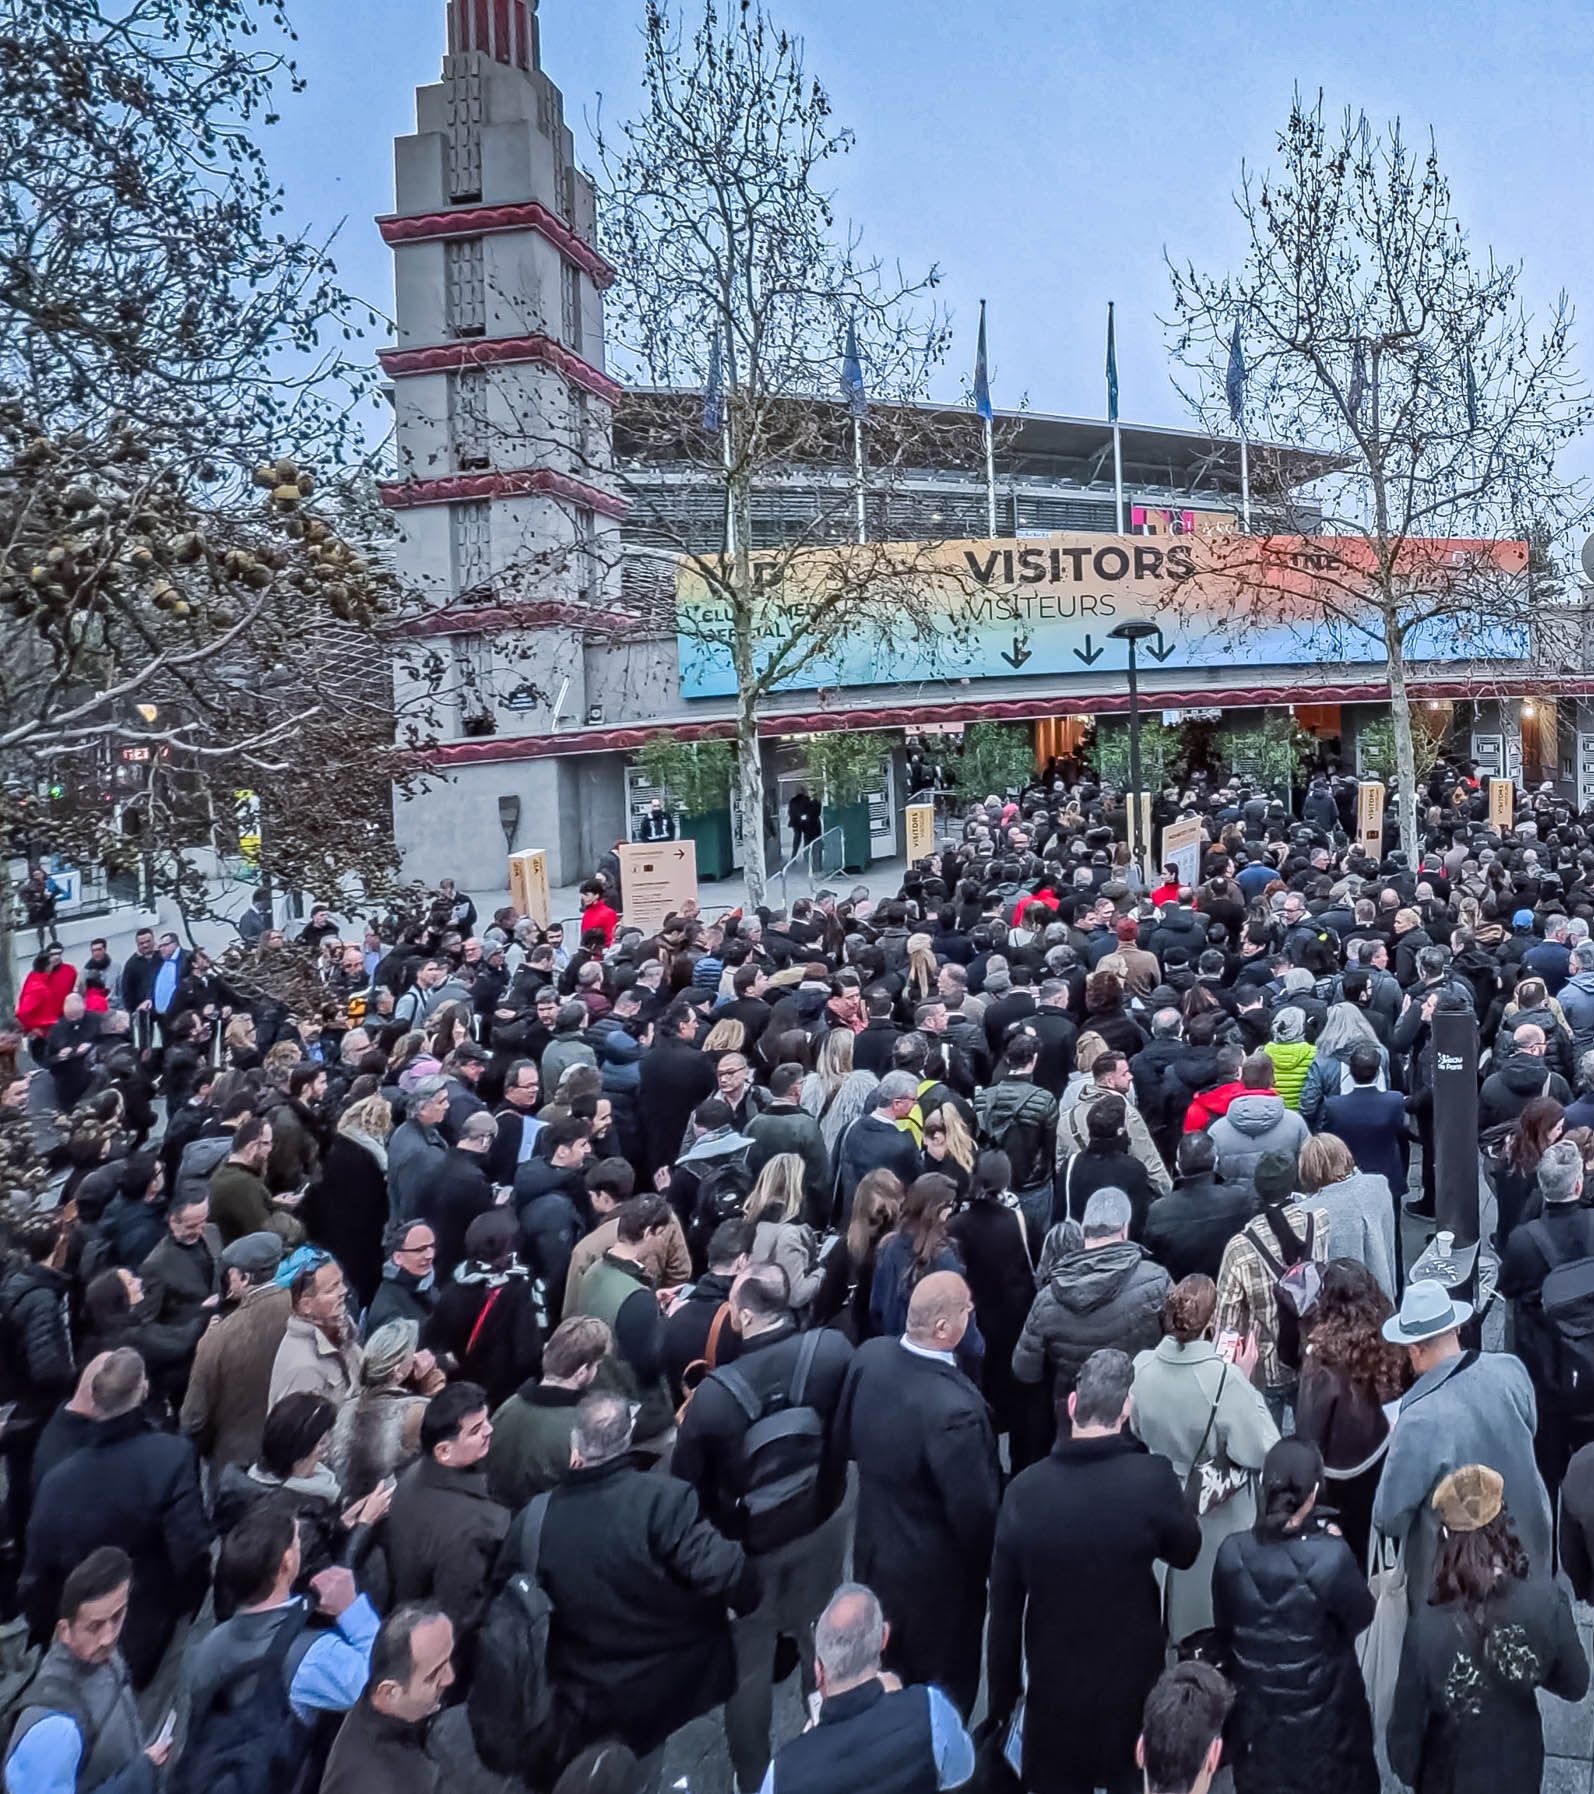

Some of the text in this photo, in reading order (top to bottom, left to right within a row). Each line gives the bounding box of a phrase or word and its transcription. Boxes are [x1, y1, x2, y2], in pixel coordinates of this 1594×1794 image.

[963, 544, 1196, 586] VISITORS
[965, 593, 1116, 622] VISITEURS
[911, 811, 919, 848] VISITORS
